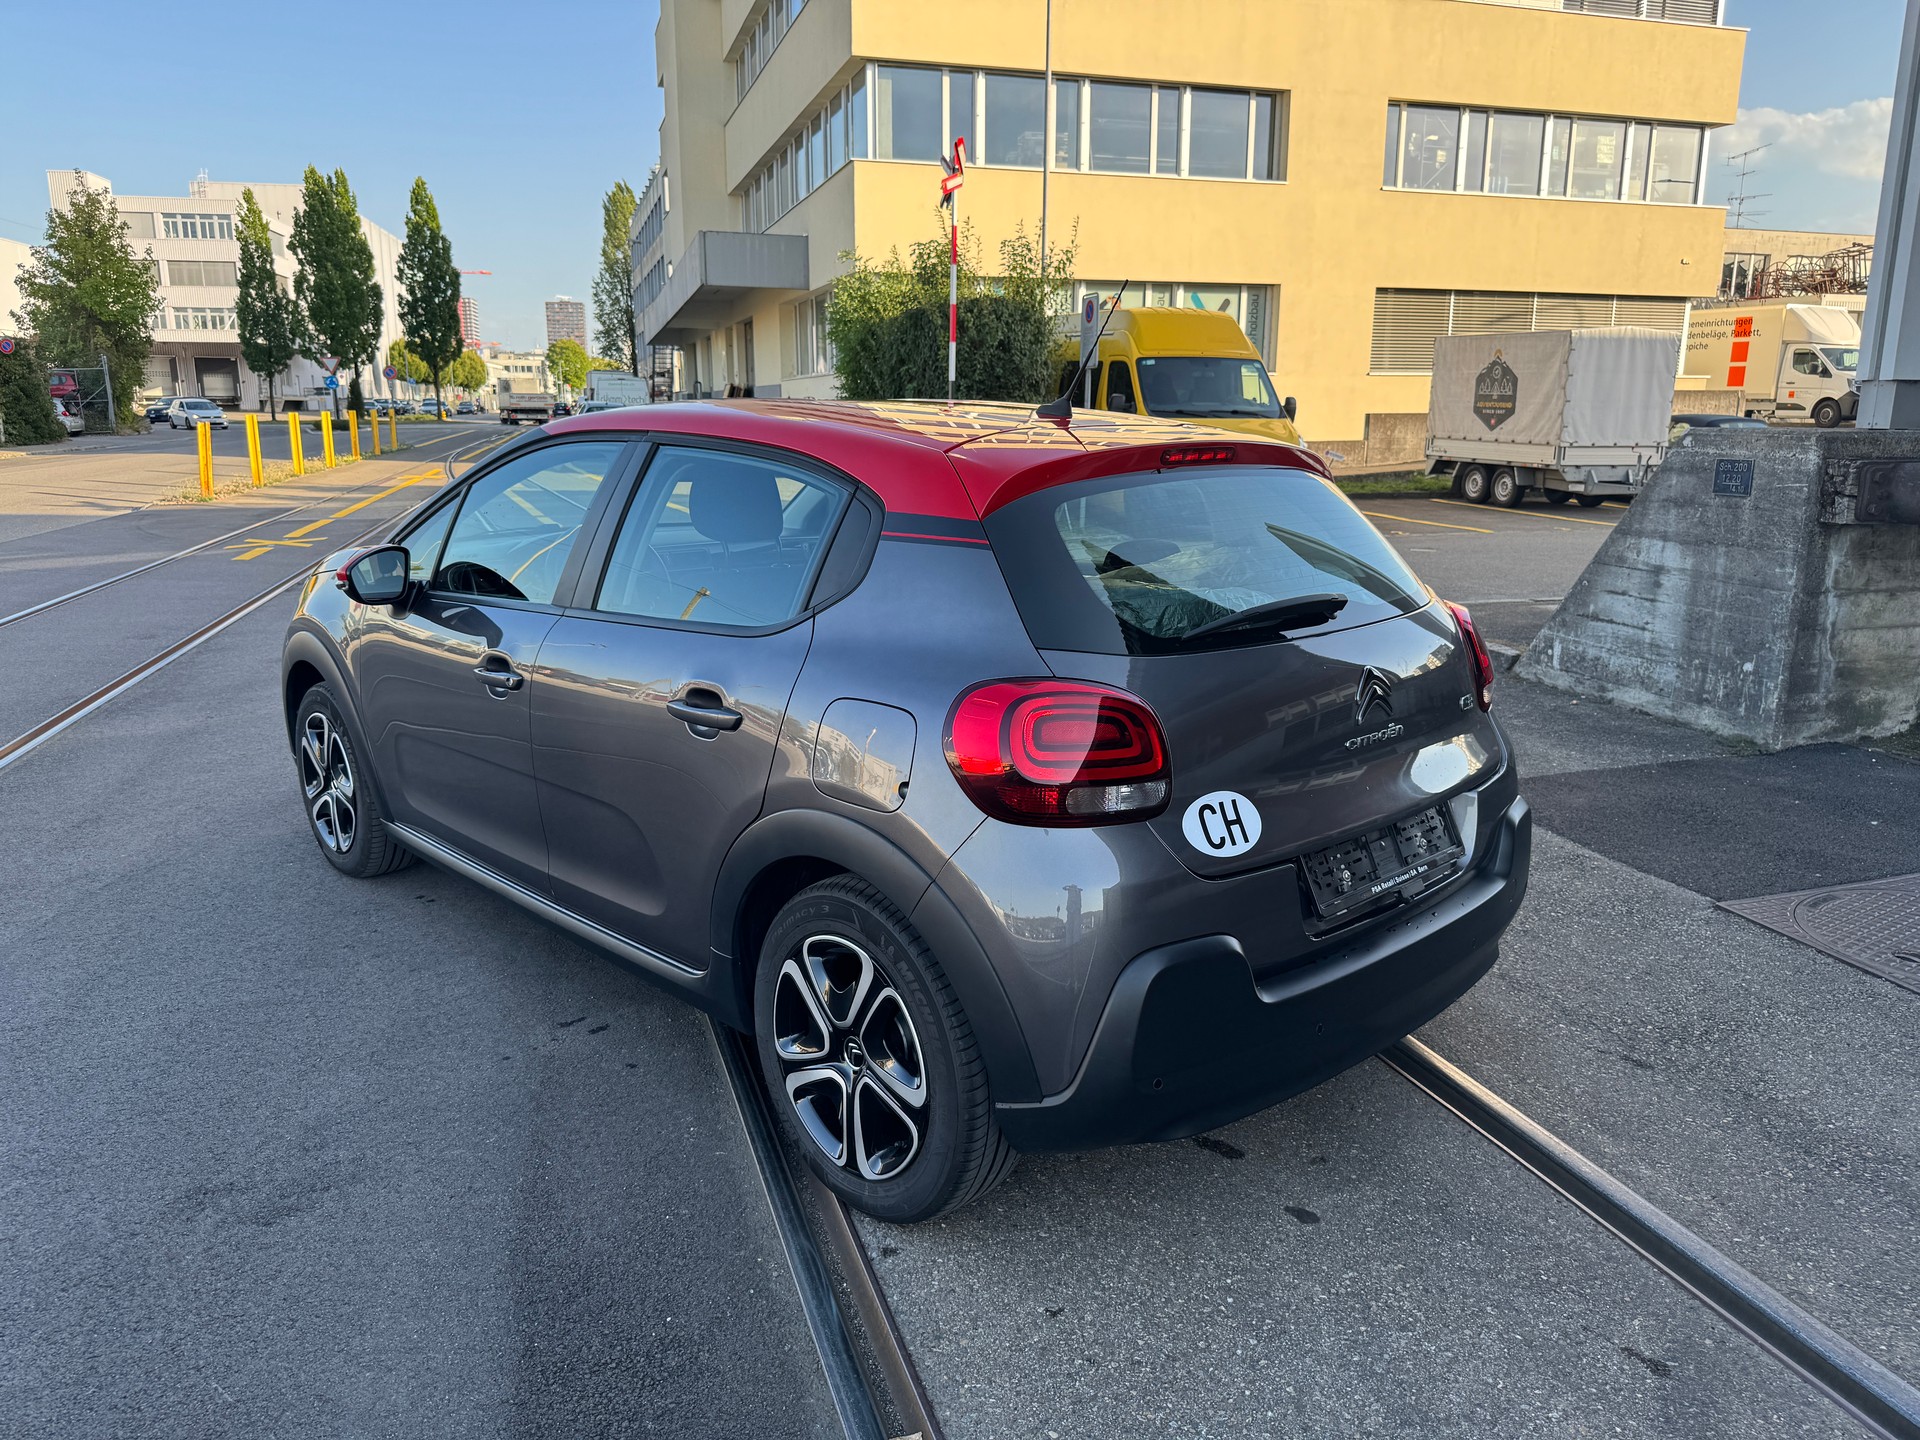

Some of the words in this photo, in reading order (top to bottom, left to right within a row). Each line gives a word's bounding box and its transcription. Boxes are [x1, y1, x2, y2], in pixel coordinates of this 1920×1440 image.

[1248, 294, 1260, 336] holzbau
[1730, 328, 1762, 338] Parkett,
[1198, 799, 1250, 850] CH
[1371, 885, 1383, 894] PSA
[1417, 865, 1429, 873] Bern
[820, 904, 830, 914] 3
